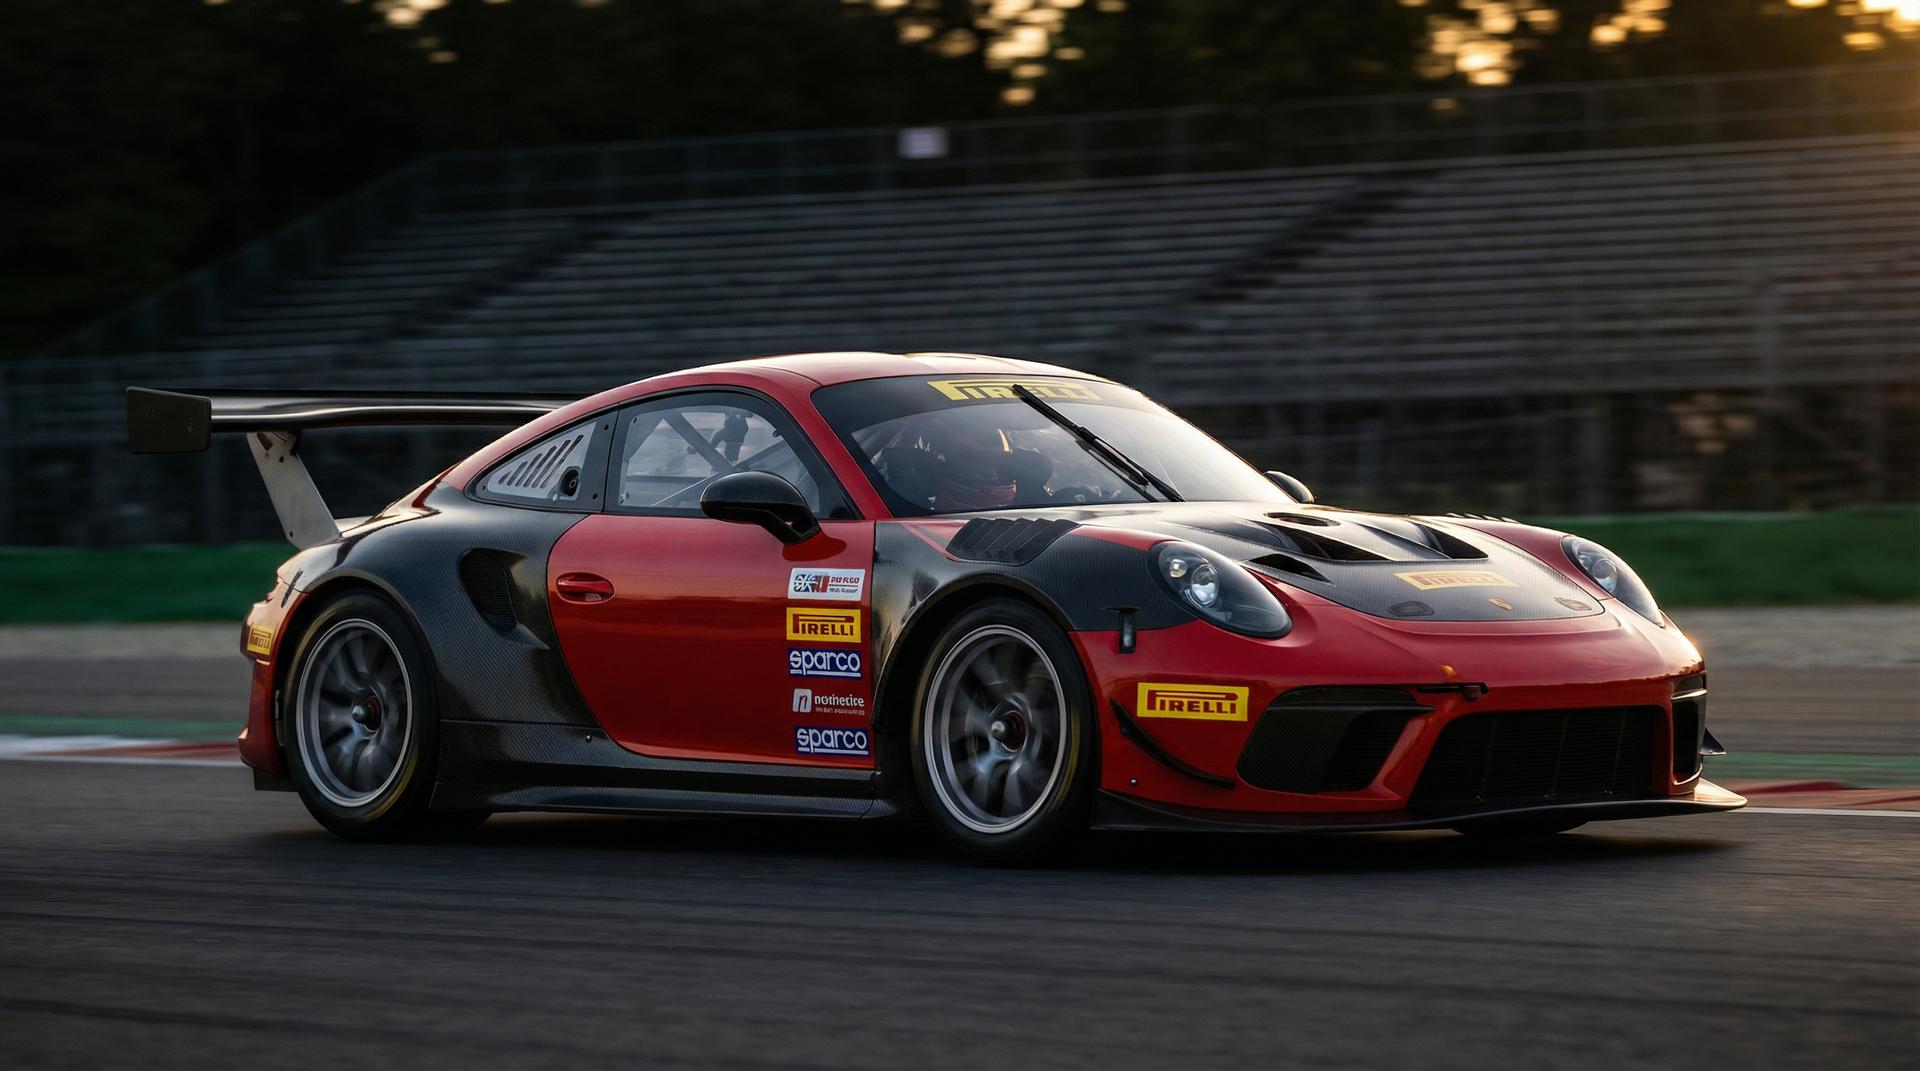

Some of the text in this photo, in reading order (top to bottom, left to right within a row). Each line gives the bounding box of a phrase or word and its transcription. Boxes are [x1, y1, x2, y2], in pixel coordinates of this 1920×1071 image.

[792, 613, 855, 636] PIRELLI
[789, 650, 861, 675] sparco
[1147, 689, 1238, 714] PIRELLI
[796, 728, 868, 753] sparco
